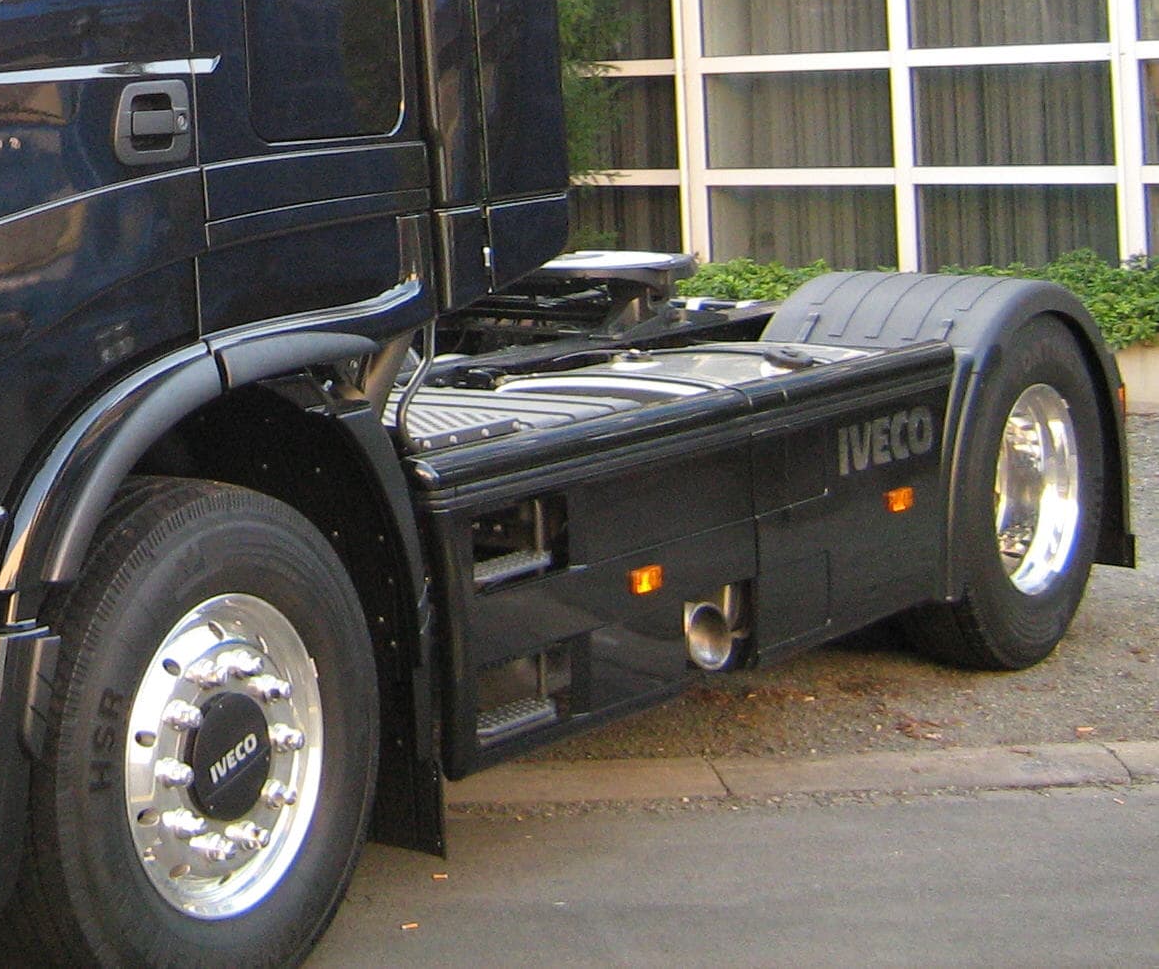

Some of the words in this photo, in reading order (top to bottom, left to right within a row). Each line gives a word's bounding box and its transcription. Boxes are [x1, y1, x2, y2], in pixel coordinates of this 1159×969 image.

[838, 406, 933, 476] IVECO
[89, 686, 125, 792] HSR
[209, 733, 258, 785] IVECO
